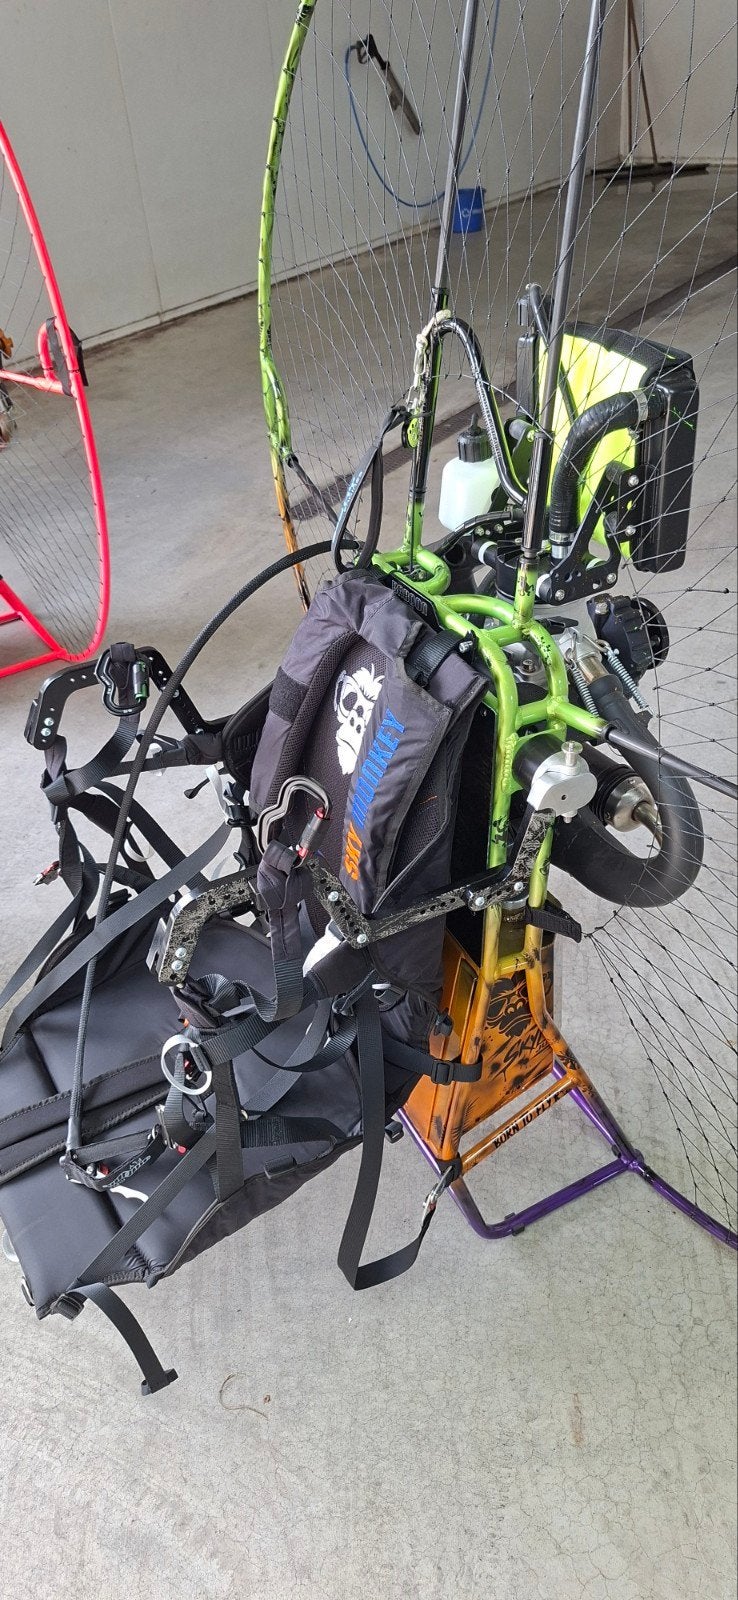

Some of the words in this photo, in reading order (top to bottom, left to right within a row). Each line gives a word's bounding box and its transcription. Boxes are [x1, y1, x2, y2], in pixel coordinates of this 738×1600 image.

[352, 708, 405, 829] MONKEY
[344, 821, 362, 881] SKY
[493, 1120, 519, 1149] BORN
